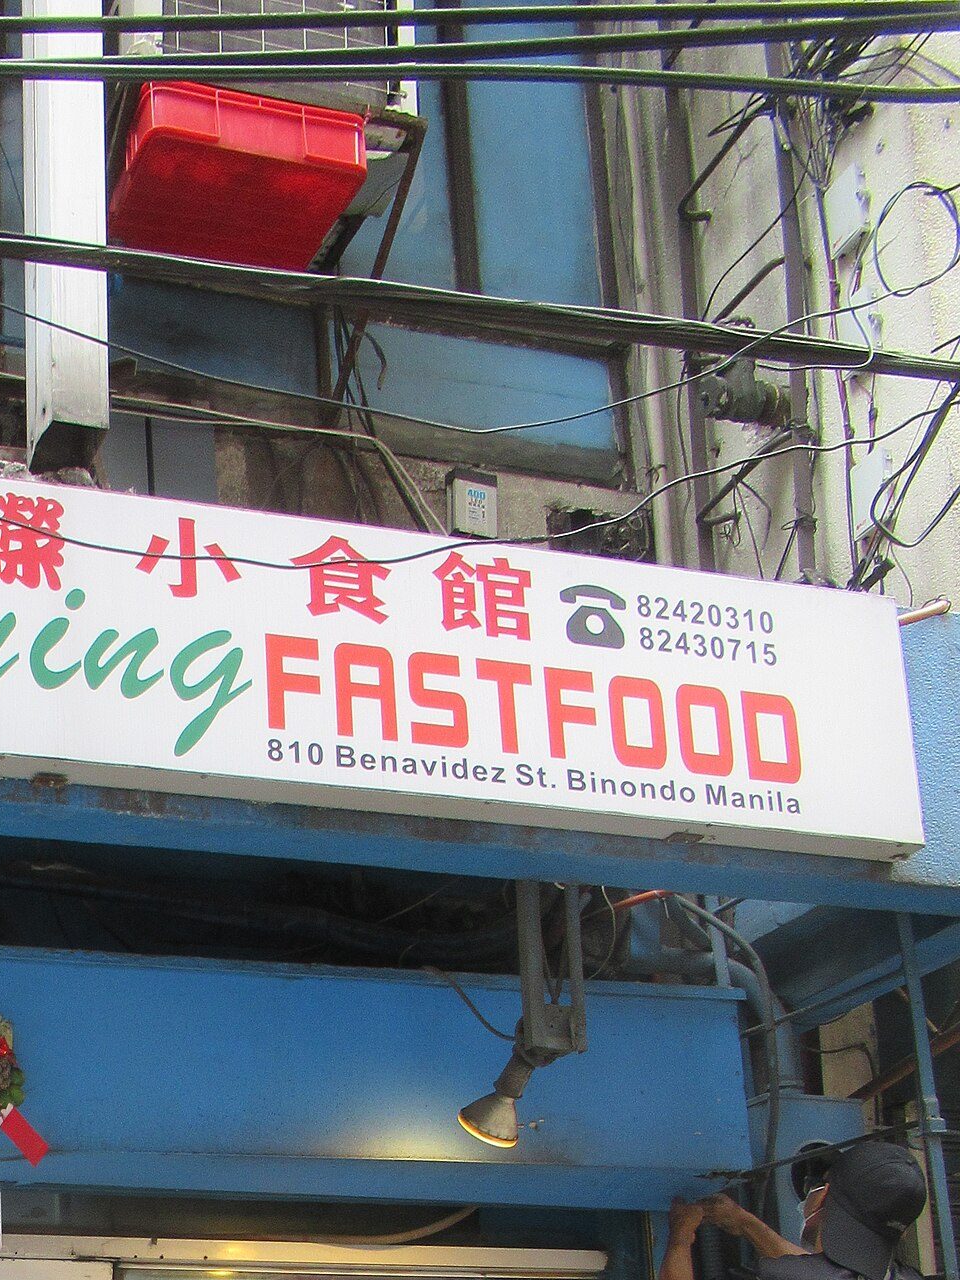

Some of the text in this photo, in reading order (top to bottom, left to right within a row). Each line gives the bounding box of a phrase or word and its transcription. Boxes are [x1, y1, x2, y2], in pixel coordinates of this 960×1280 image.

[637, 594, 774, 634] 82420310
[639, 627, 778, 666] 82430715
[265, 633, 802, 785] FASTFOOD
[267, 738, 802, 815] 810 Benavidez St. Binondo Manila
